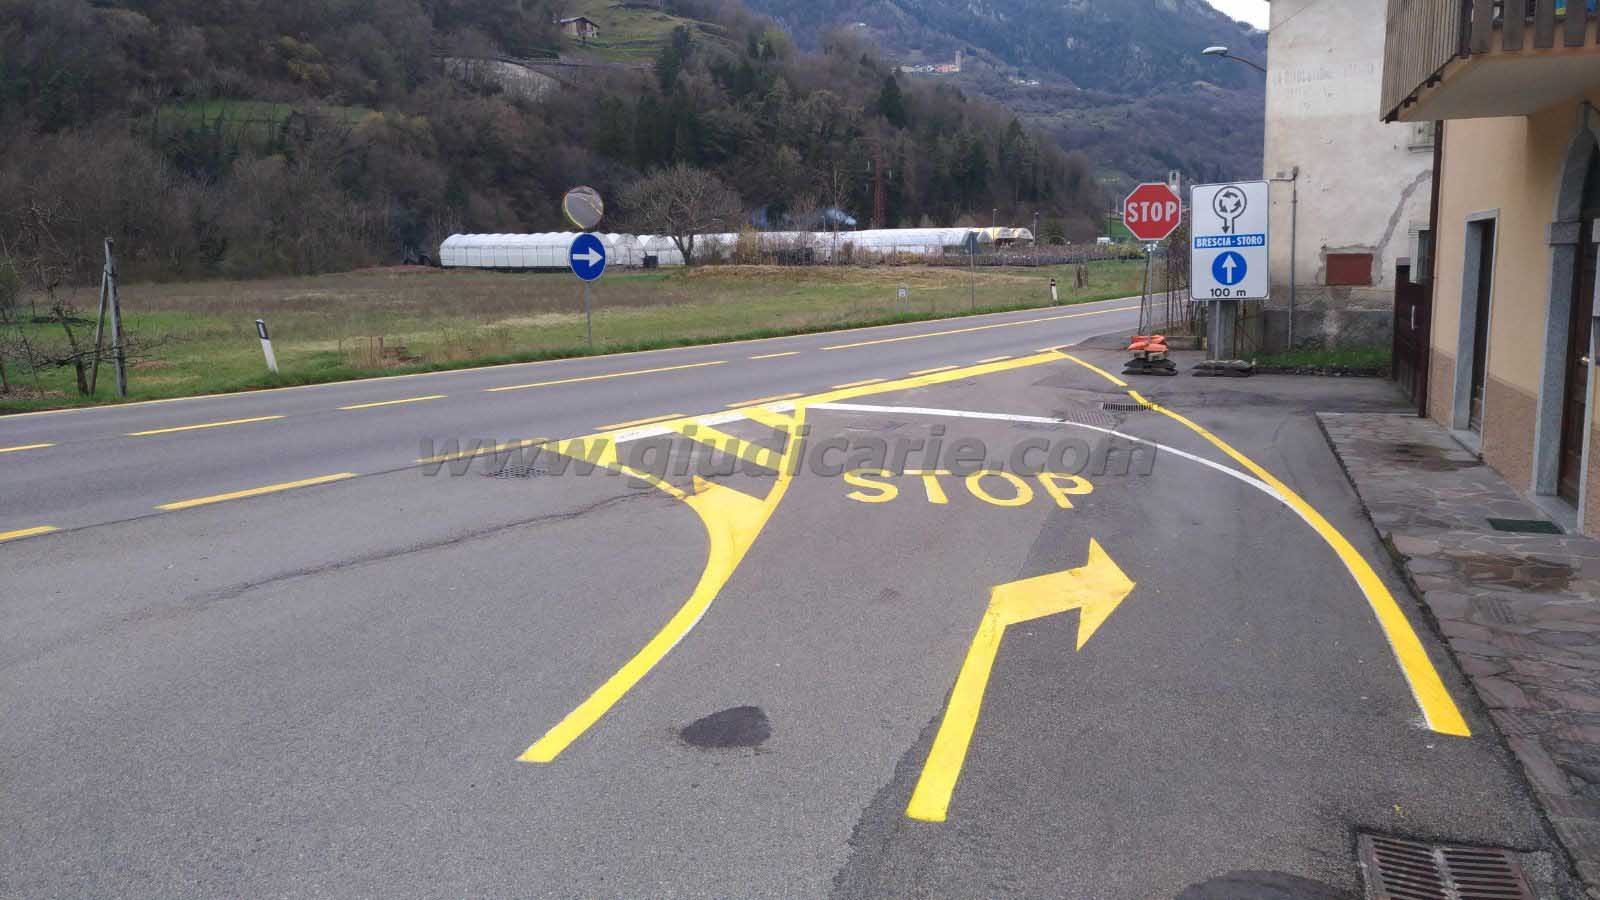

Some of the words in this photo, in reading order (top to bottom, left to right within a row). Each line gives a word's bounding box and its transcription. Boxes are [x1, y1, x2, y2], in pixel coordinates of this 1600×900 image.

[1127, 201, 1177, 223] STOP
[1210, 288, 1231, 297] 100
[843, 467, 1095, 509] STOP
